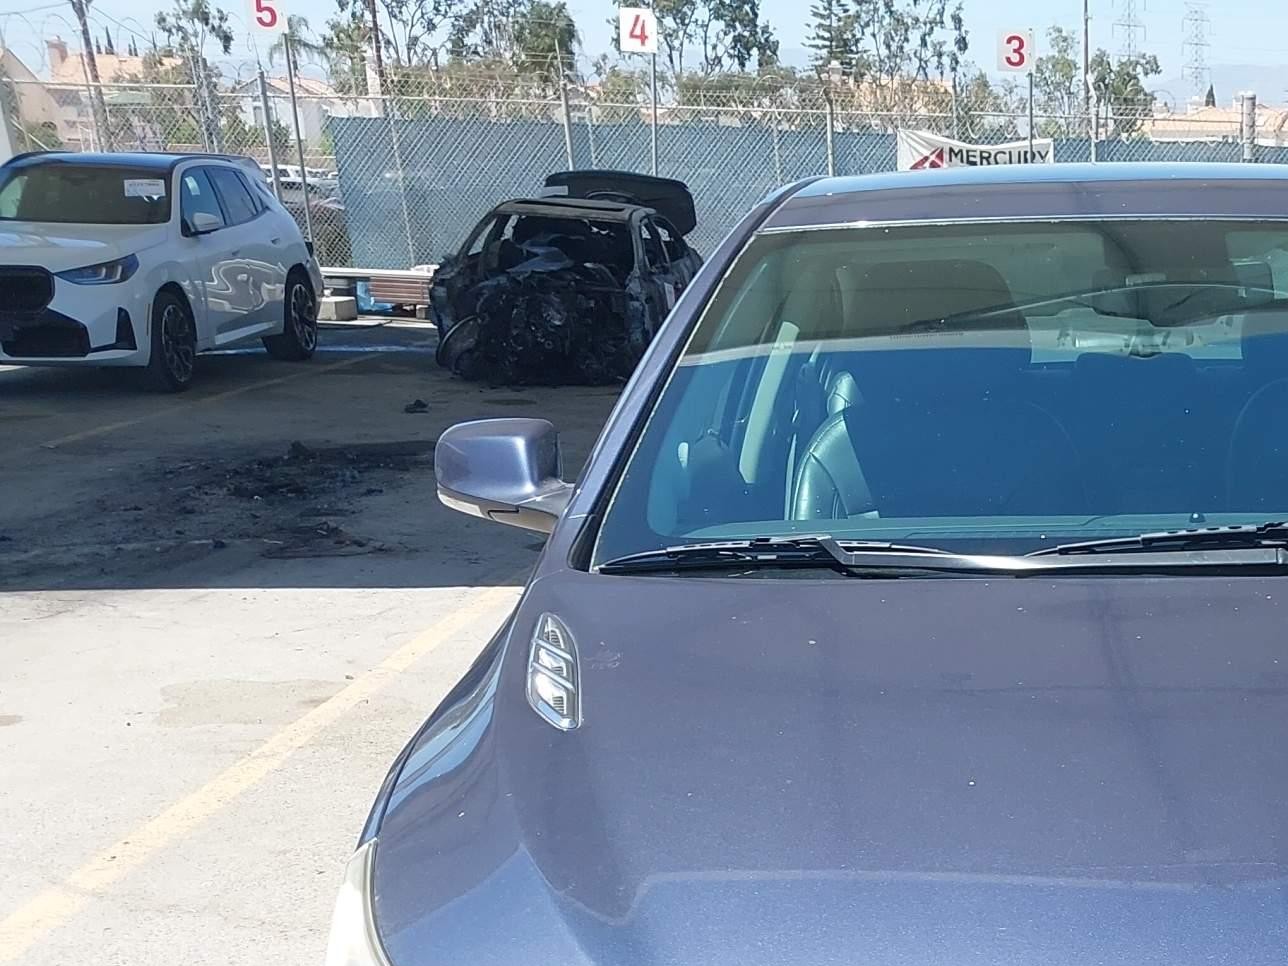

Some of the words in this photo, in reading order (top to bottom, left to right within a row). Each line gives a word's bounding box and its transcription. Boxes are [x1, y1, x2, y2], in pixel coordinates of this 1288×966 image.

[255, 0, 278, 27] 5
[629, 14, 649, 47] 4
[1005, 35, 1025, 67] 3
